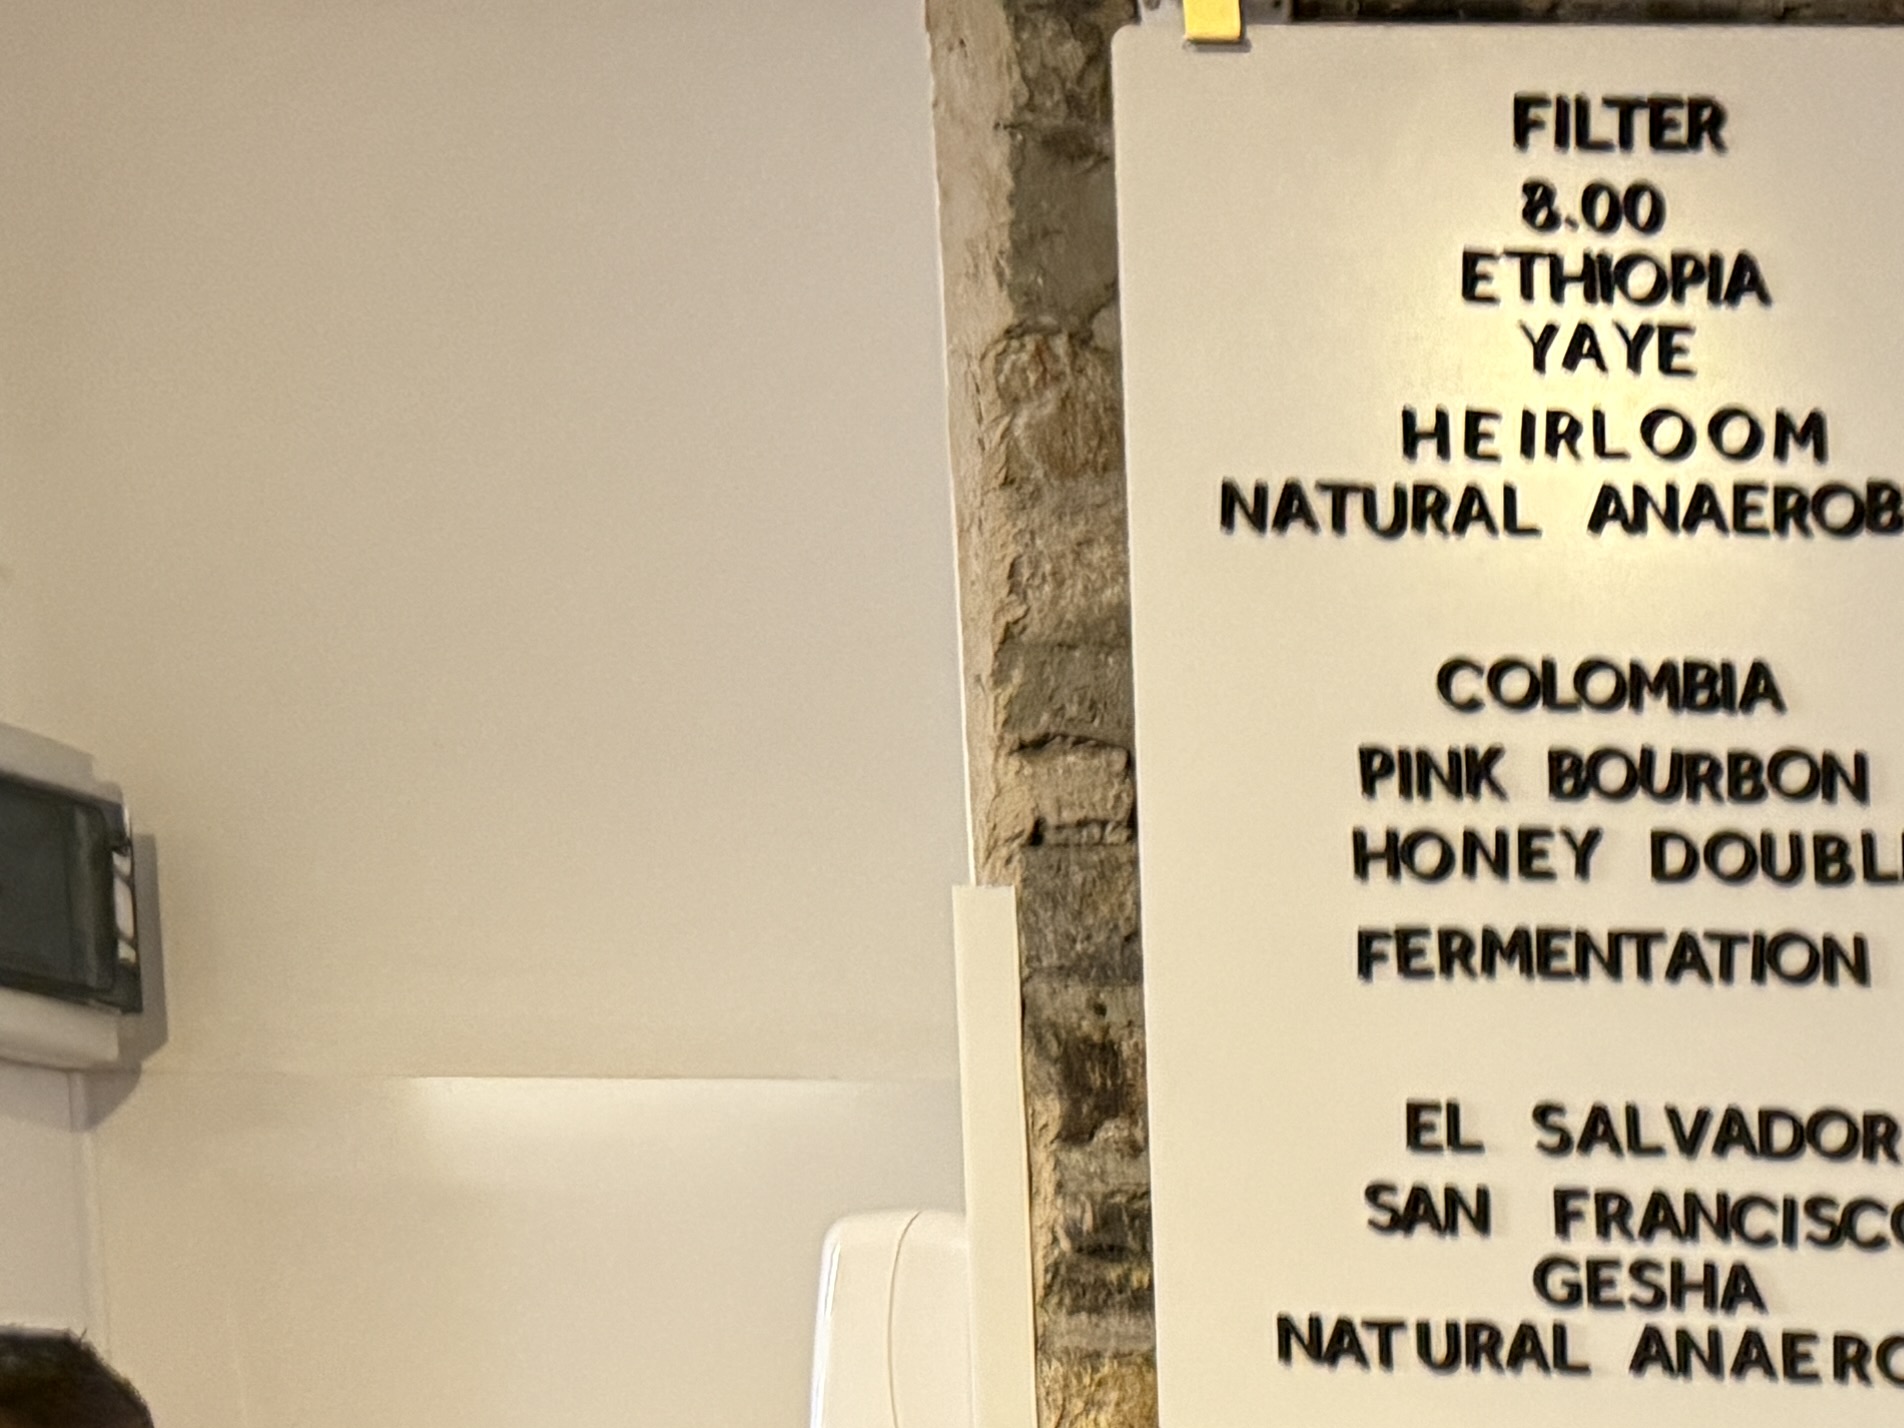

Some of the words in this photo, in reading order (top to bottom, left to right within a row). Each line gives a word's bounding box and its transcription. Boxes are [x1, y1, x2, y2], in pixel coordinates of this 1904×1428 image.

[1513, 93, 1727, 153] FILTER
[1521, 180, 1666, 235] 8.00
[1461, 250, 1772, 307] ETHIOPIA
[1521, 322, 1694, 376] YAYE
[1401, 407, 1828, 464] HEIRLOOM
[1220, 480, 1540, 540] NATURAL
[1436, 658, 1786, 715] COLOMBIA
[1358, 746, 1506, 801] PINK
[1547, 746, 1870, 805] BOURBON
[1352, 827, 1602, 883] HONEY
[1357, 927, 1870, 987] FERMENTATION
[1406, 1101, 1484, 1153] EL
[1532, 1103, 1901, 1164] SALVADOR
[1364, 1183, 1491, 1236] SAN
[1532, 1255, 1767, 1314] GESHA
[1276, 1314, 1591, 1375] NATURAL
